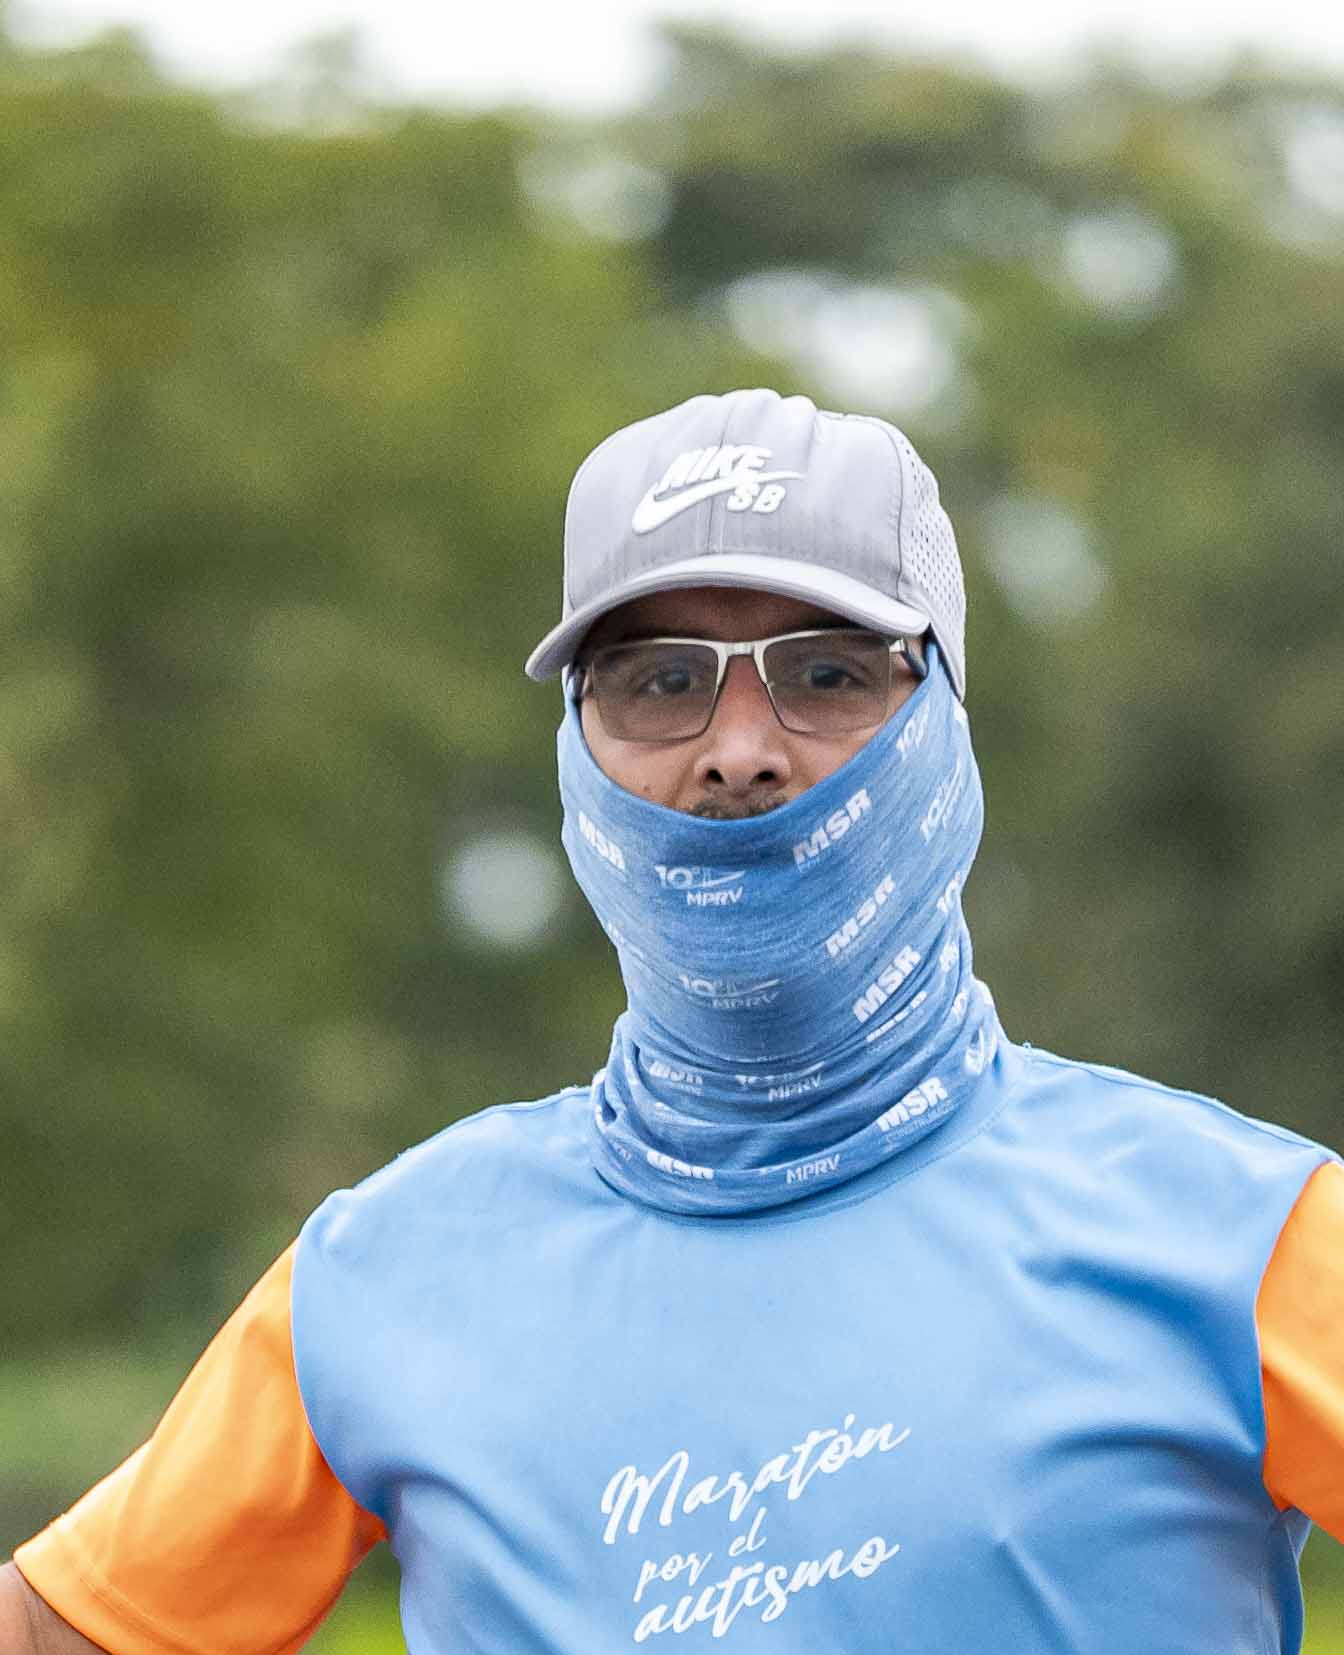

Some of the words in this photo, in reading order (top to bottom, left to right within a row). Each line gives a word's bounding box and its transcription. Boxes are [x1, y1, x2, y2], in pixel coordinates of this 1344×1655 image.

[656, 444, 773, 490] NIKE
[727, 482, 786, 513] SB
[578, 810, 626, 872] MSR
[793, 788, 871, 865] MSR
[825, 873, 896, 958] MSR
[853, 944, 921, 1024] MSR
[875, 1076, 949, 1132] MSR
[785, 1153, 840, 1184] MPRV
[600, 1413, 911, 1544] Maratón
[633, 1550, 712, 1603] por
[728, 1507, 768, 1558] el
[633, 1536, 900, 1643] autismo
